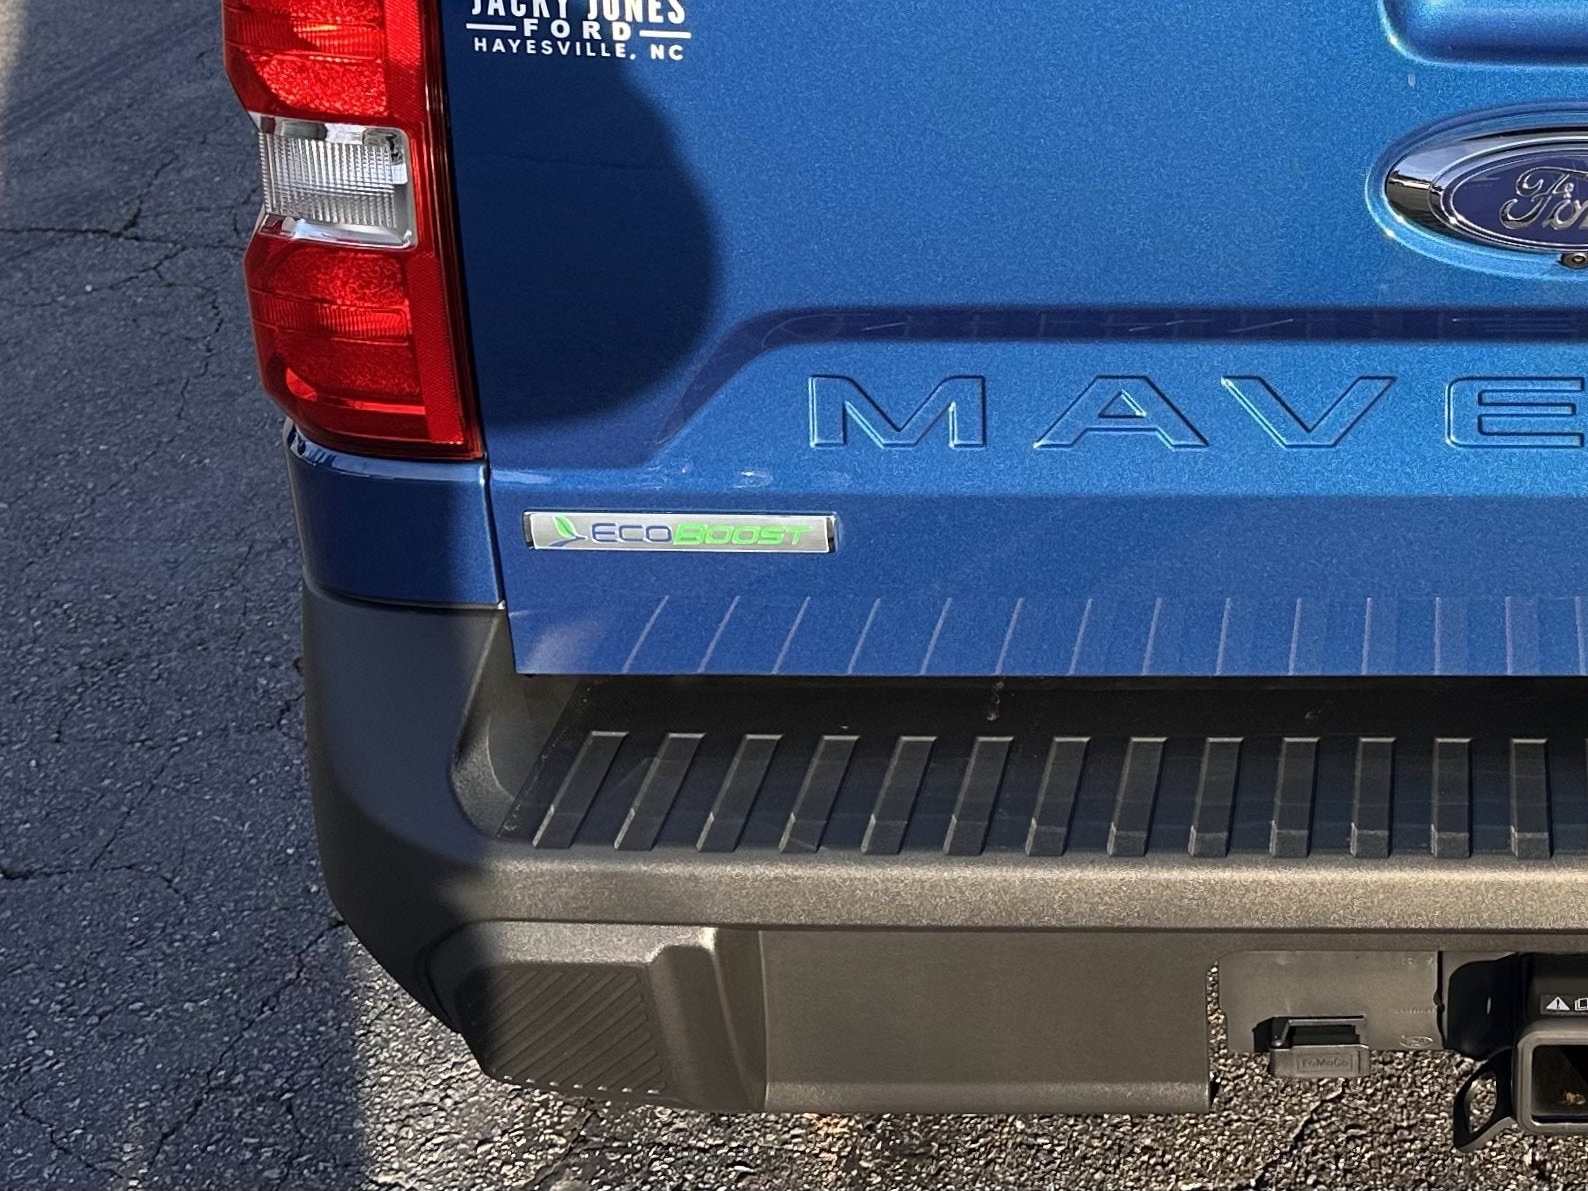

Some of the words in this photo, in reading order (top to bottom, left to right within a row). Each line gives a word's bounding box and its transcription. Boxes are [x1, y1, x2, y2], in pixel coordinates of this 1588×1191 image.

[523, 18, 632, 42] FORD
[473, 37, 636, 60] HAYESVILLE,
[650, 44, 684, 61] NC
[590, 522, 814, 546] ECOBOOST
